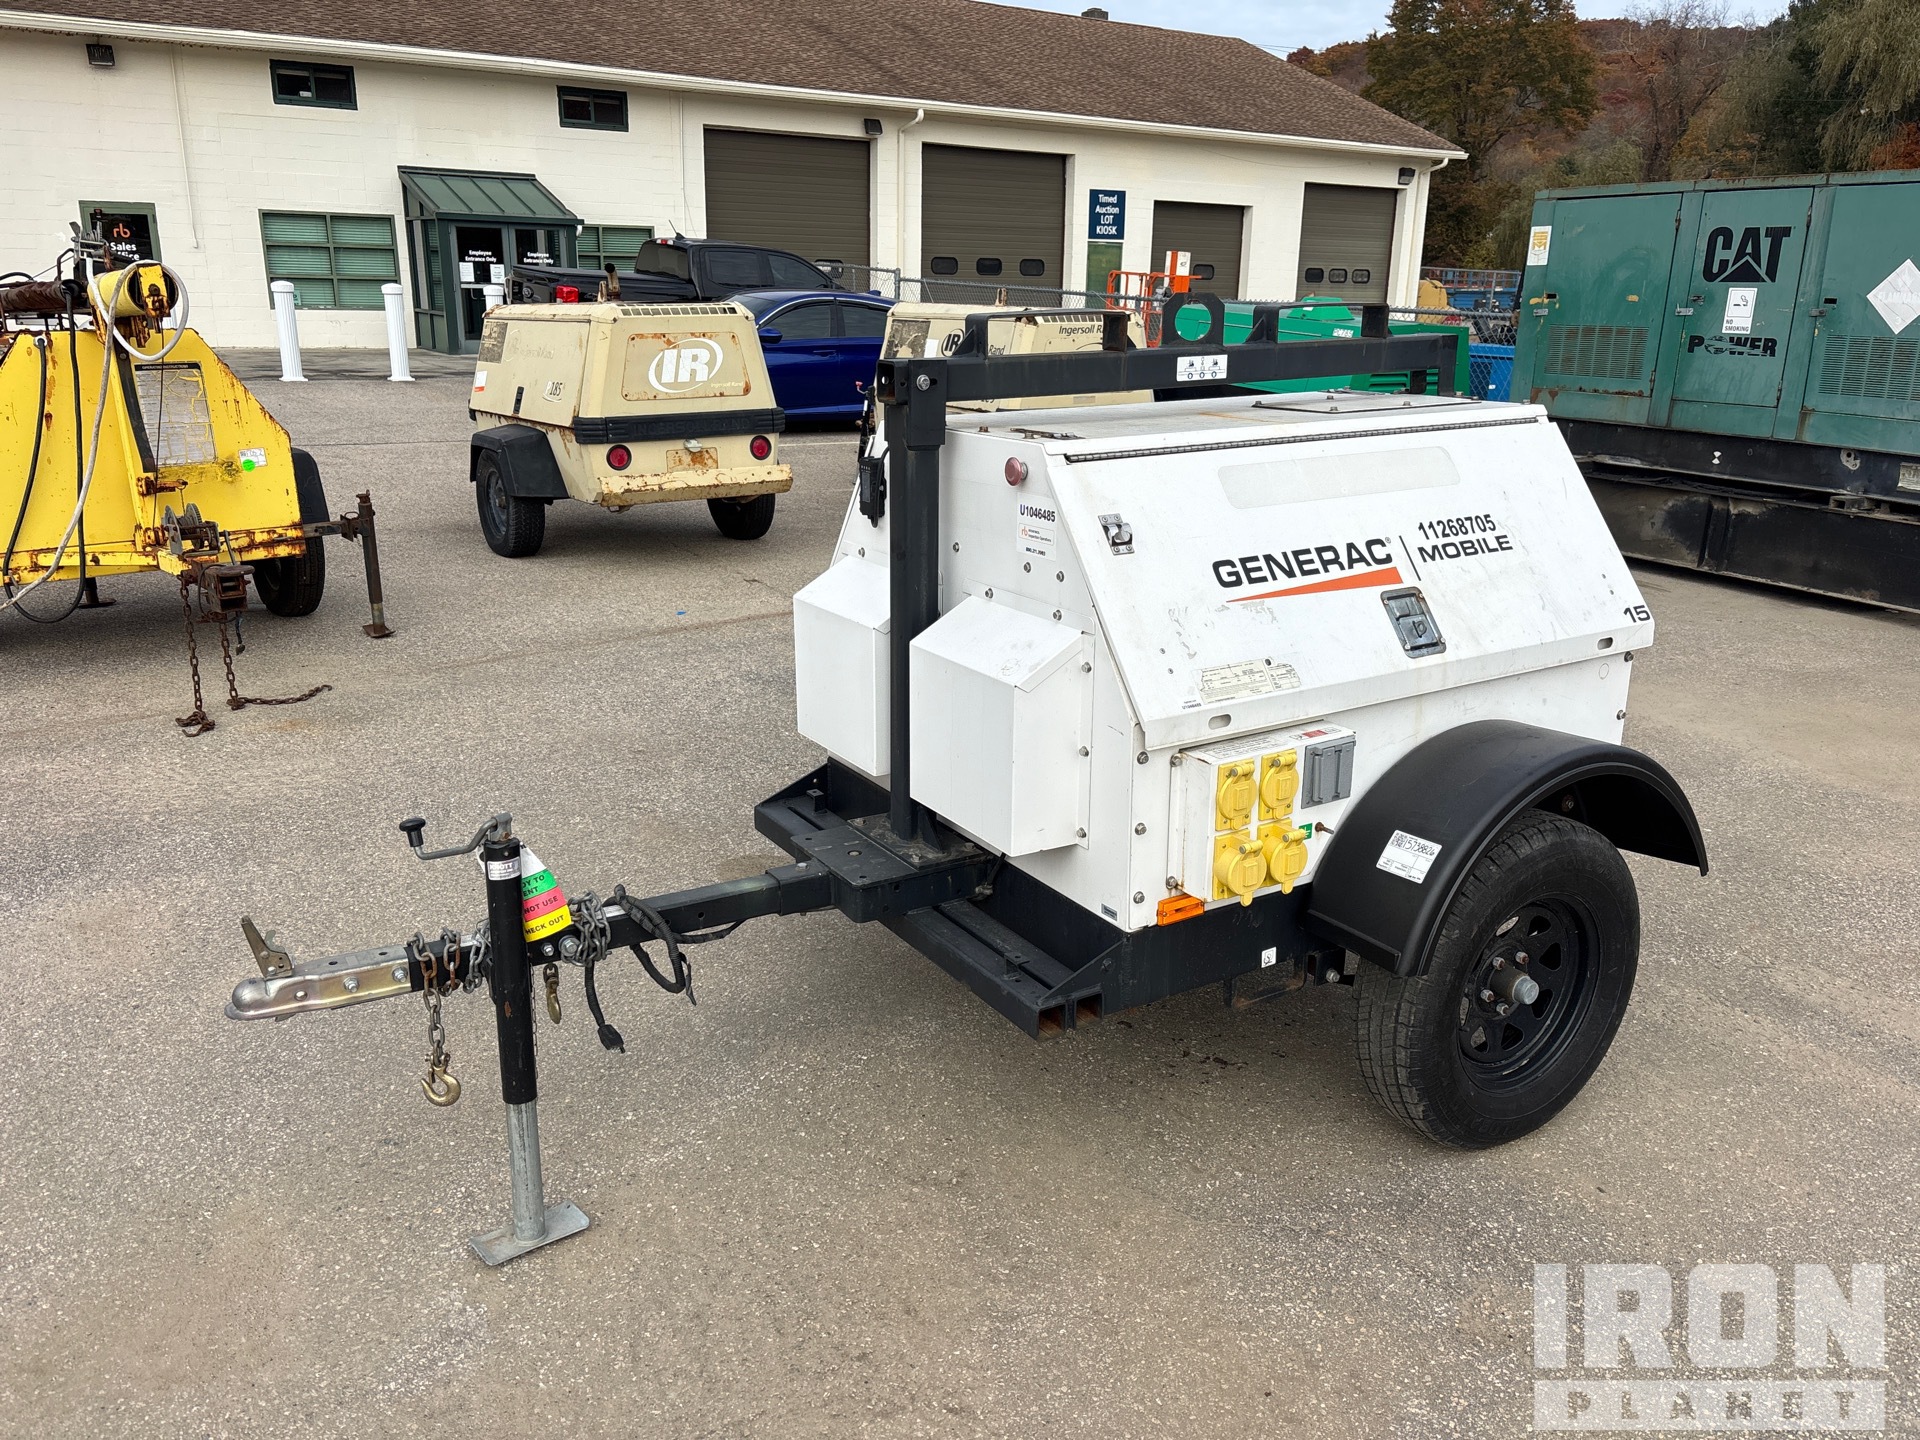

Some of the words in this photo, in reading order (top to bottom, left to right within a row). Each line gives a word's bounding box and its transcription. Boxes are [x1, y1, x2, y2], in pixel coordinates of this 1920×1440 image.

[1098, 194, 1118, 204] Timed
[1095, 205, 1120, 214] Auction
[1100, 215, 1114, 224] LOT
[113, 223, 130, 238] rb
[1096, 225, 1117, 235] KIOSK
[110, 242, 137, 251] Sales
[1703, 226, 1792, 283] CAT
[1059, 324, 1095, 336] Ingersoll
[989, 344, 1006, 355] Rand
[661, 348, 711, 383] IR
[1020, 504, 1056, 522] U1046485
[1417, 513, 1497, 541] 11268705
[1417, 534, 1514, 563] MOBILE
[1212, 537, 1393, 588] GENERAC
[1623, 604, 1651, 623] 15
[534, 874, 545, 883] TO
[523, 886, 539, 897] ENT
[524, 904, 540, 914] NOT
[542, 895, 559, 907] USE
[525, 923, 547, 935] HECK
[548, 914, 564, 926] OUT
